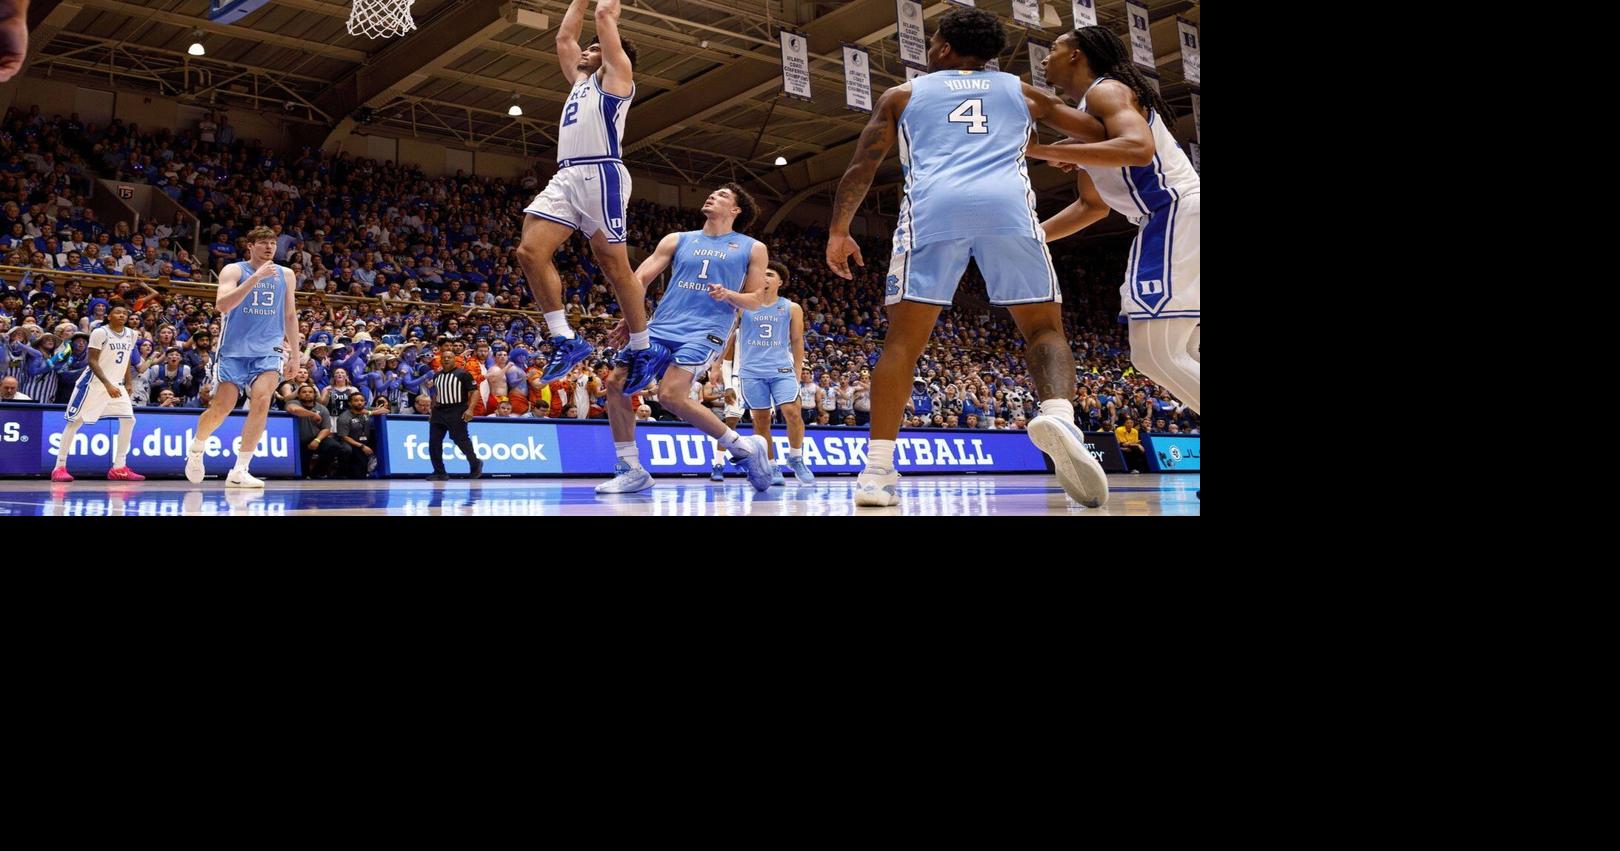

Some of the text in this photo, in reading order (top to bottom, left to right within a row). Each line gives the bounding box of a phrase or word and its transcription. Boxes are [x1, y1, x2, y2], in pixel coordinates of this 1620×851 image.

[944, 79, 991, 91] YOUNG
[948, 98, 988, 134] 4
[121, 188, 132, 199] 15
[693, 249, 727, 260] NORTH
[698, 259, 710, 279] 1
[251, 291, 275, 306] 13
[243, 307, 276, 315] CAROLIN
[759, 323, 772, 339] 3
[747, 339, 781, 347] CAROLINA
[115, 351, 124, 364] 3
[772, 436, 994, 466] BASKTBALL
